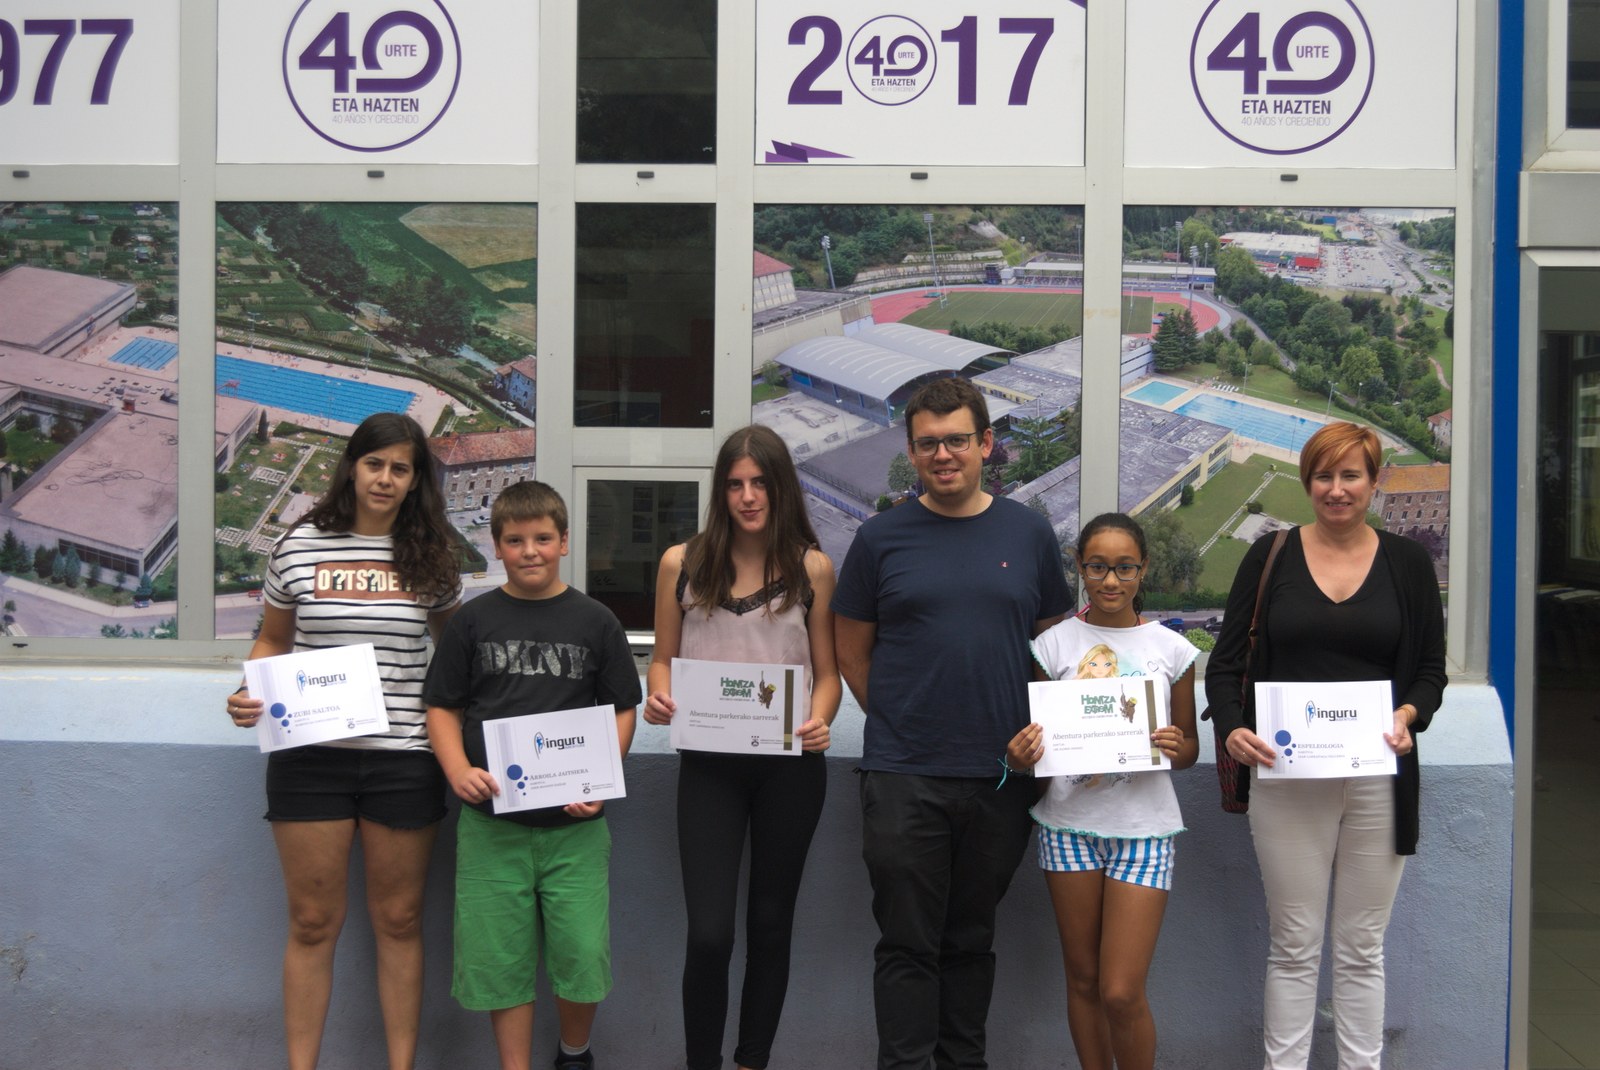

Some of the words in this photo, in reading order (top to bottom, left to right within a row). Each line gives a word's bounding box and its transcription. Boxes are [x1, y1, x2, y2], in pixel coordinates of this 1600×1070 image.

[298, 10, 444, 94] 40
[384, 44, 418, 58] URTE
[854, 35, 928, 76] 40
[897, 51, 915, 59] URTE
[1206, 10, 1357, 95] 40
[1296, 45, 1330, 58] URTE
[871, 78, 885, 86] ETA
[887, 78, 916, 86] HAZTEN
[332, 98, 359, 113] ETA
[363, 98, 420, 113] HAZTEN
[1241, 100, 1268, 114] ETA
[1273, 100, 1331, 115] HAZTEN
[332, 114, 343, 124] 40
[368, 115, 374, 124] Y
[375, 114, 419, 124] CRECIENDO
[1241, 117, 1252, 126] 40
[1277, 117, 1284, 126] Y
[1285, 117, 1331, 126] CRECIENDO
[476, 640, 591, 680] DKNY
[308, 673, 347, 687] inguru
[1317, 707, 1358, 721] inguru
[545, 736, 585, 750] inguru
